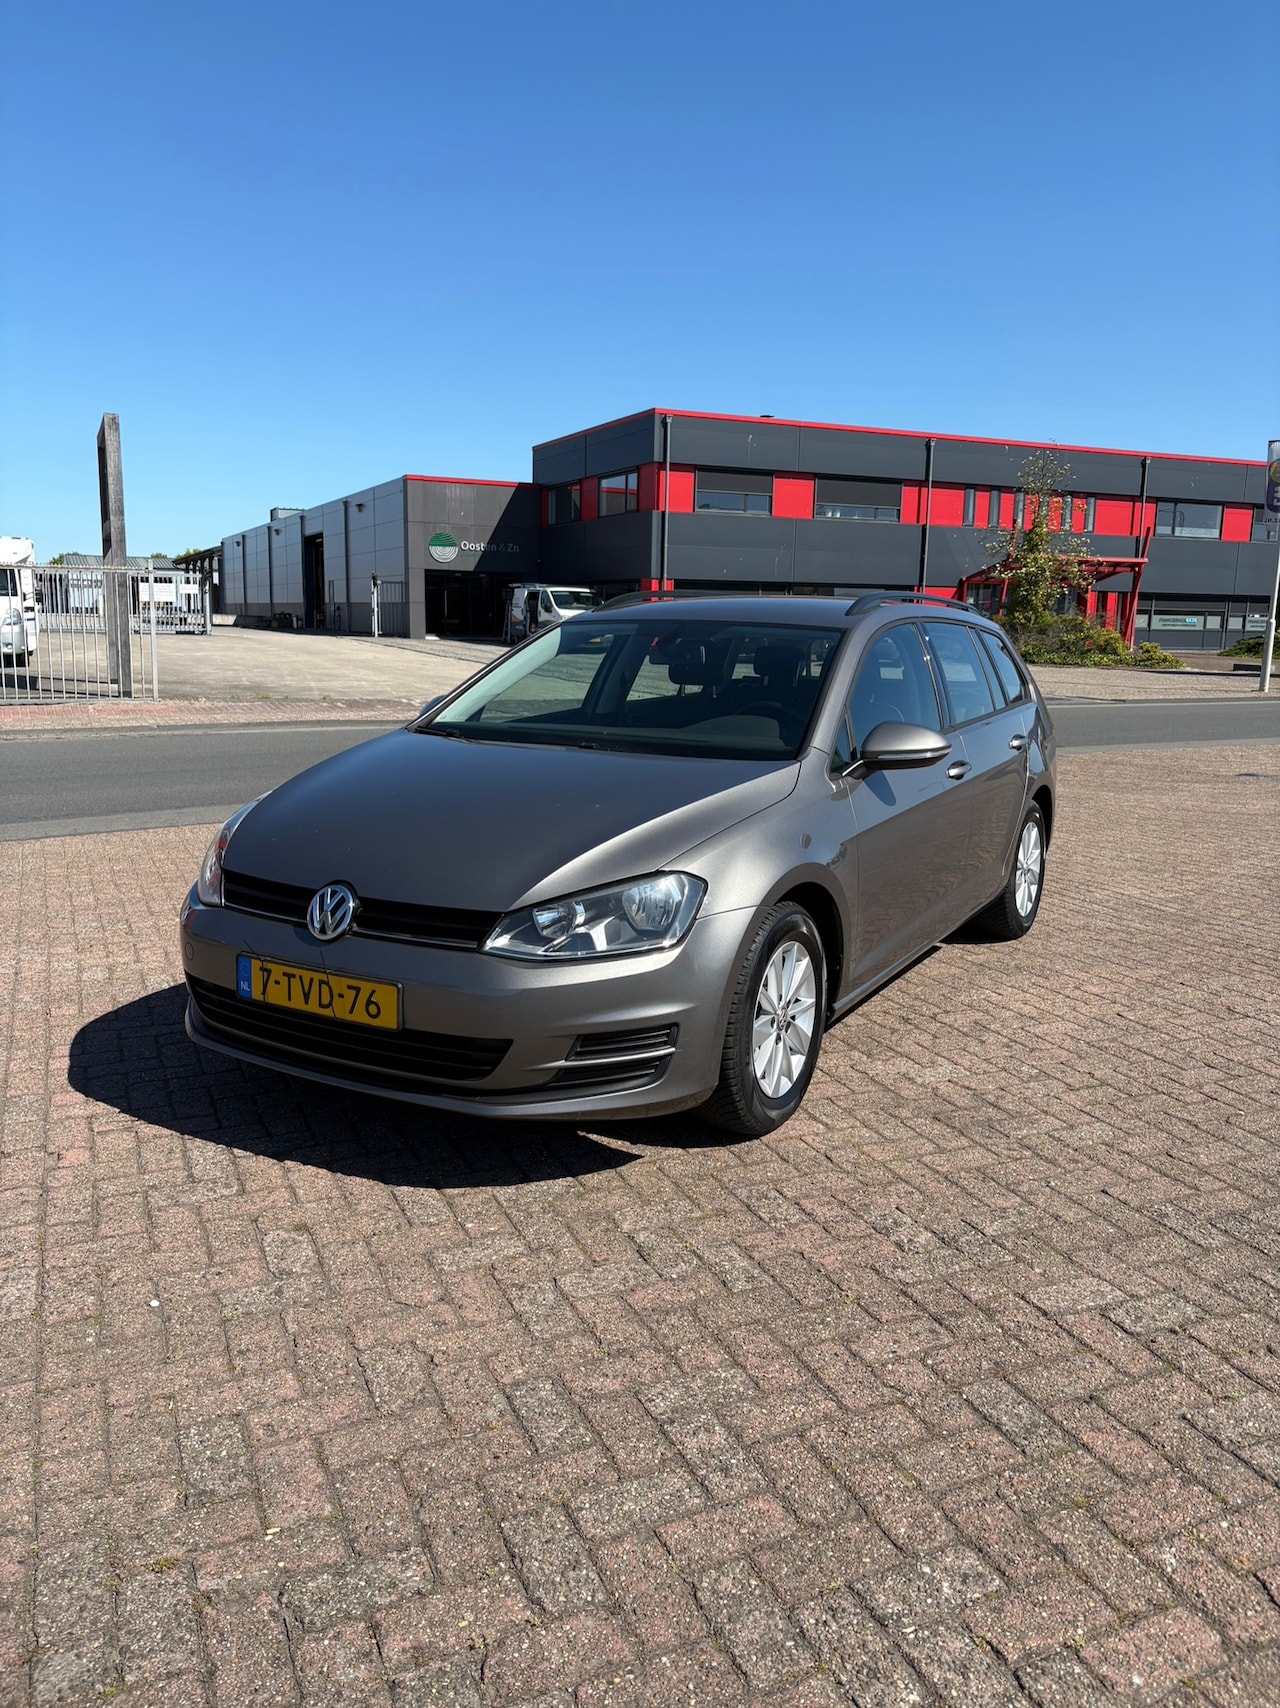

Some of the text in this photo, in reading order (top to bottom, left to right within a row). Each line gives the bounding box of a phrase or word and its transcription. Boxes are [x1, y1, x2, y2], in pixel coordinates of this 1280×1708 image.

[461, 541, 520, 552] Oosten & Zn
[240, 966, 382, 1018] NL 7-TVD-76
